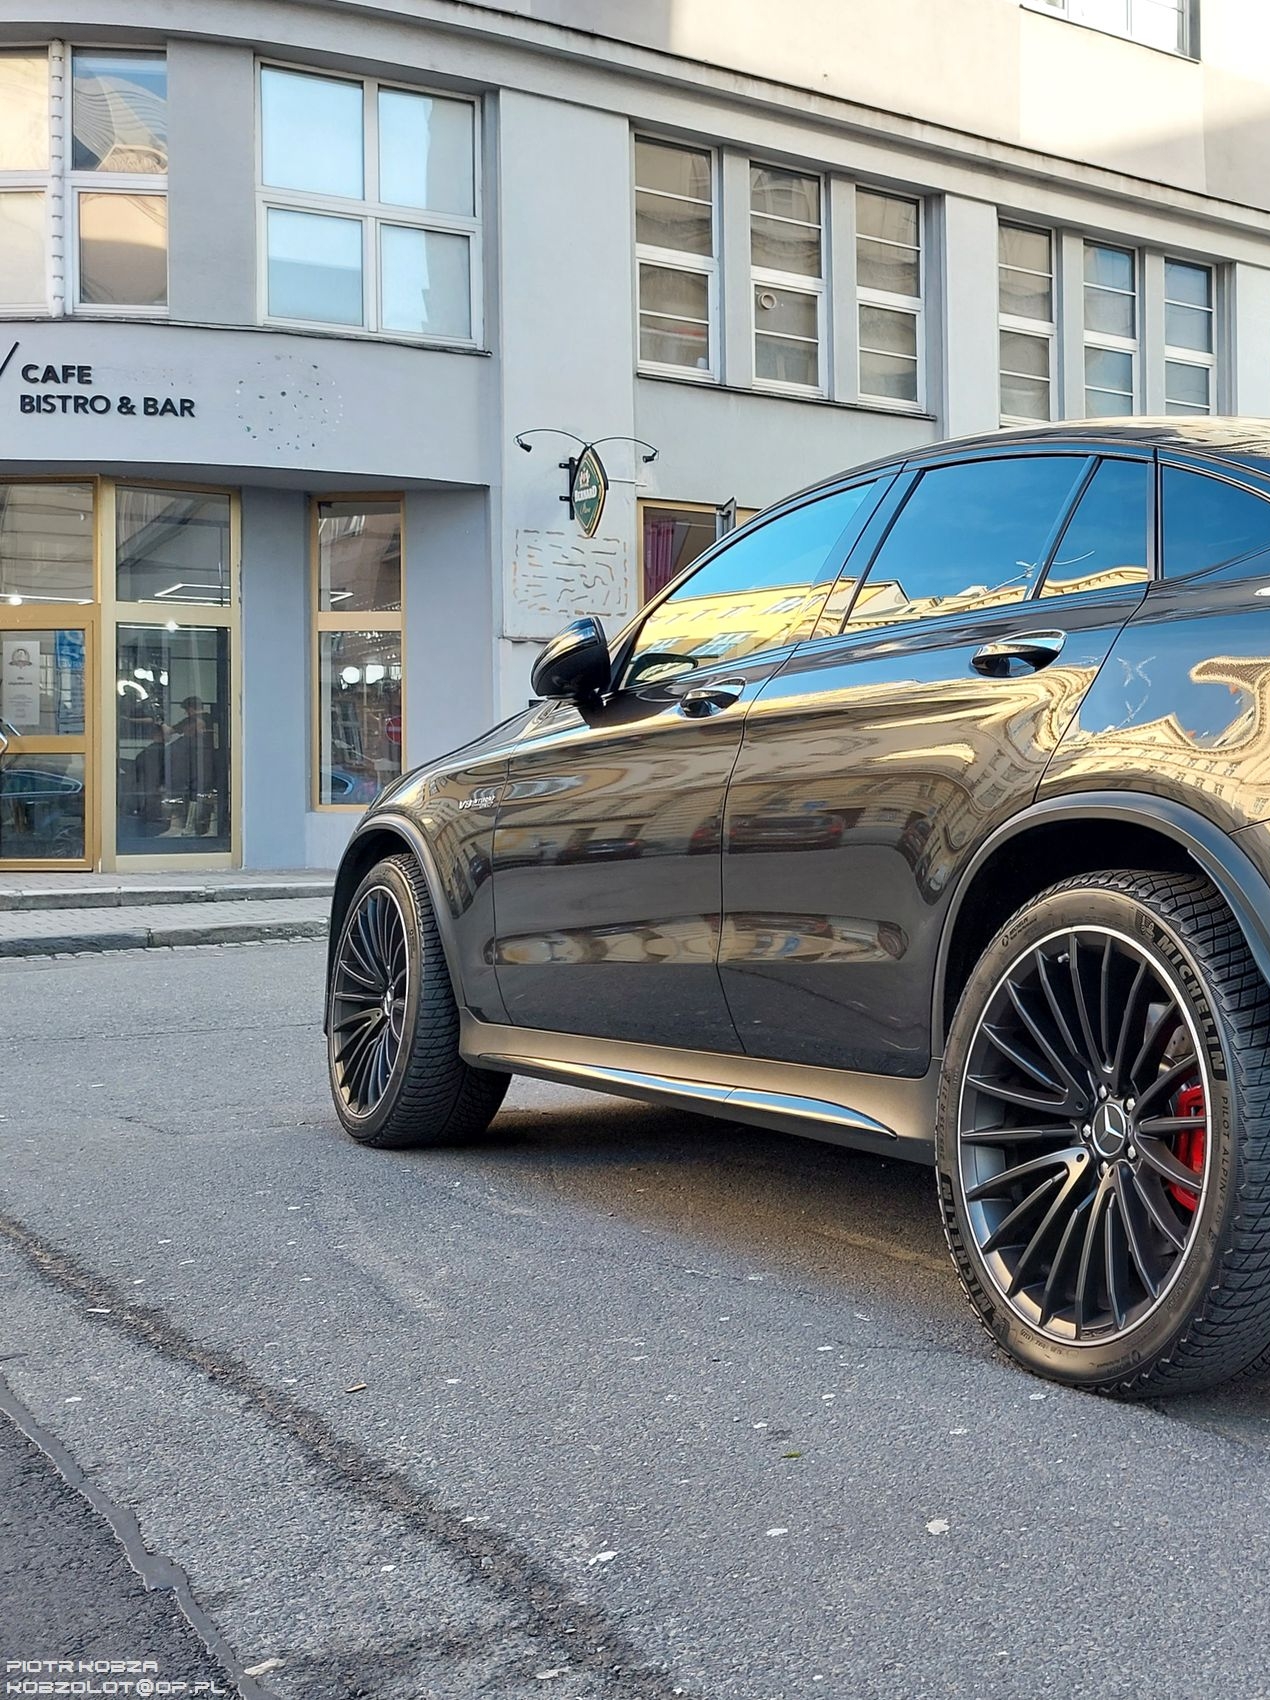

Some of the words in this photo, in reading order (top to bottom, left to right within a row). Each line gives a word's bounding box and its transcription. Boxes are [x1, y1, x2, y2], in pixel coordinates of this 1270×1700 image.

[21, 364, 93, 385] CAFE
[20, 394, 111, 415] BISTRO
[117, 397, 136, 416] &
[143, 397, 196, 418] BAR
[1157, 934, 1226, 1072] MICHELIN
[1221, 1096, 1230, 1140] PILOT
[1218, 1150, 1230, 1193] ALPIN
[941, 1182, 992, 1315] MICHELIN
